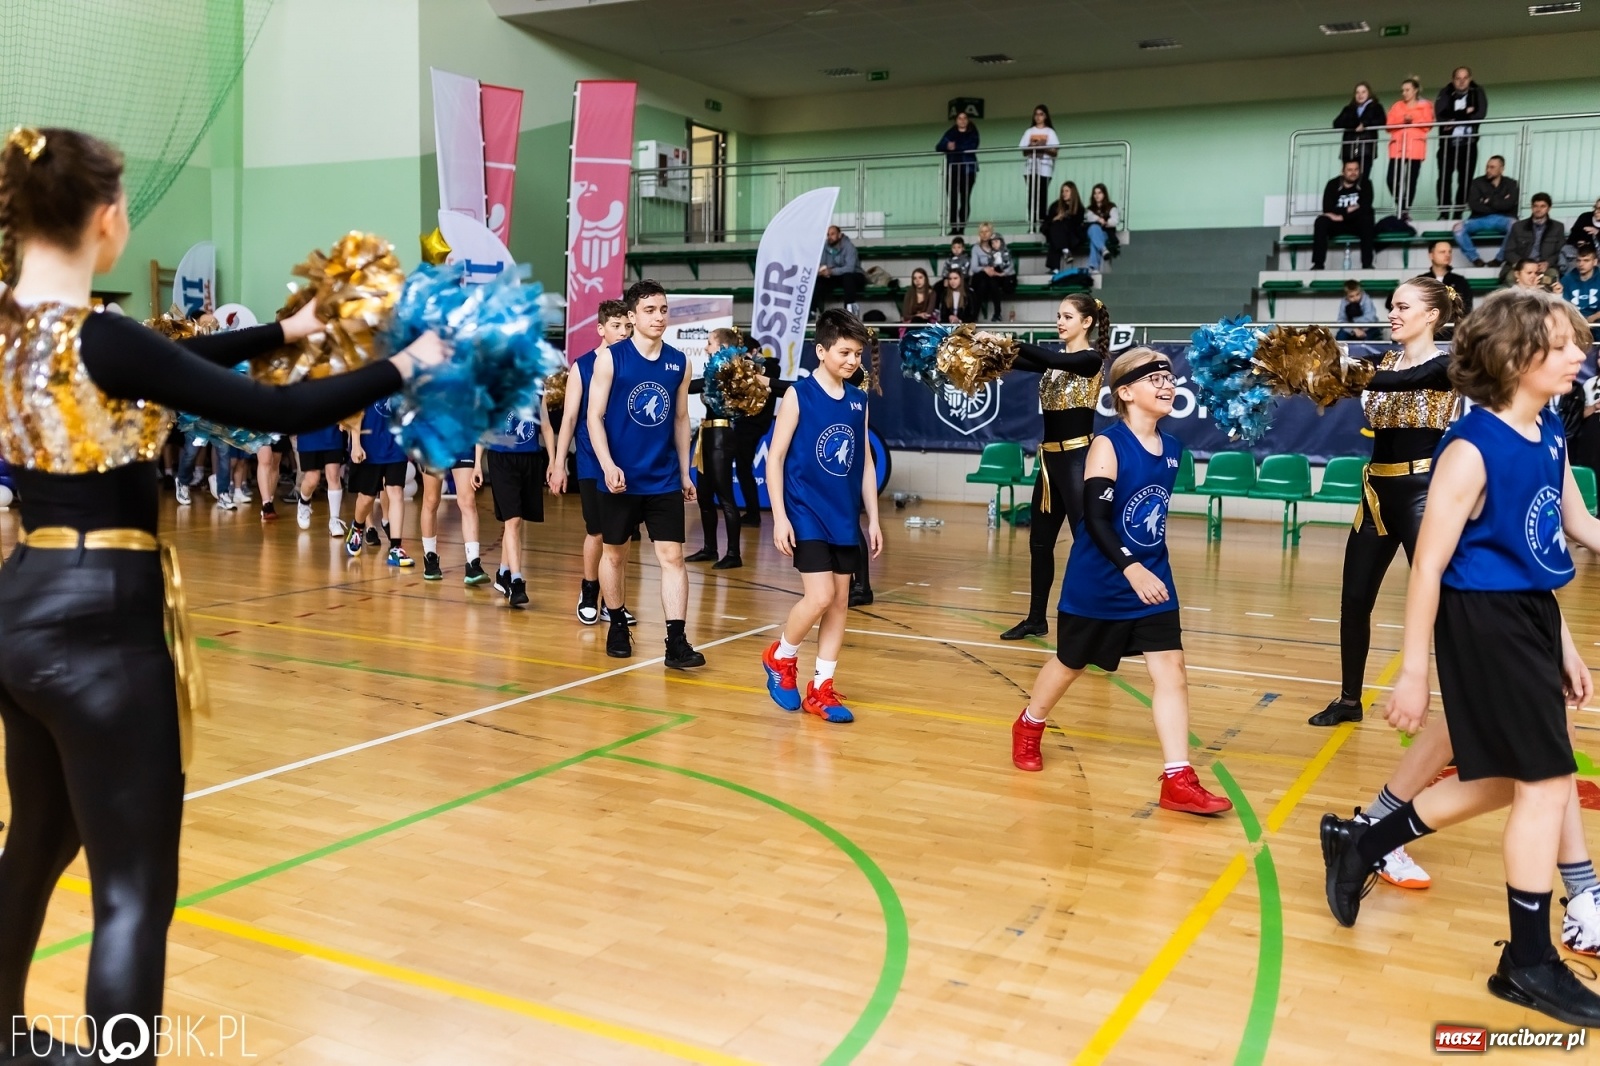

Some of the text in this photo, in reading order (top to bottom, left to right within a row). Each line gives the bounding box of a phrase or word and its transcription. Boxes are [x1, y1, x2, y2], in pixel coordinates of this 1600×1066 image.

[964, 104, 979, 117] A
[790, 266, 812, 334] RACIBÓRZ
[1114, 331, 1131, 345] B
[818, 426, 839, 457] MINNESOTA
[1125, 488, 1154, 522] MINNESOTA
